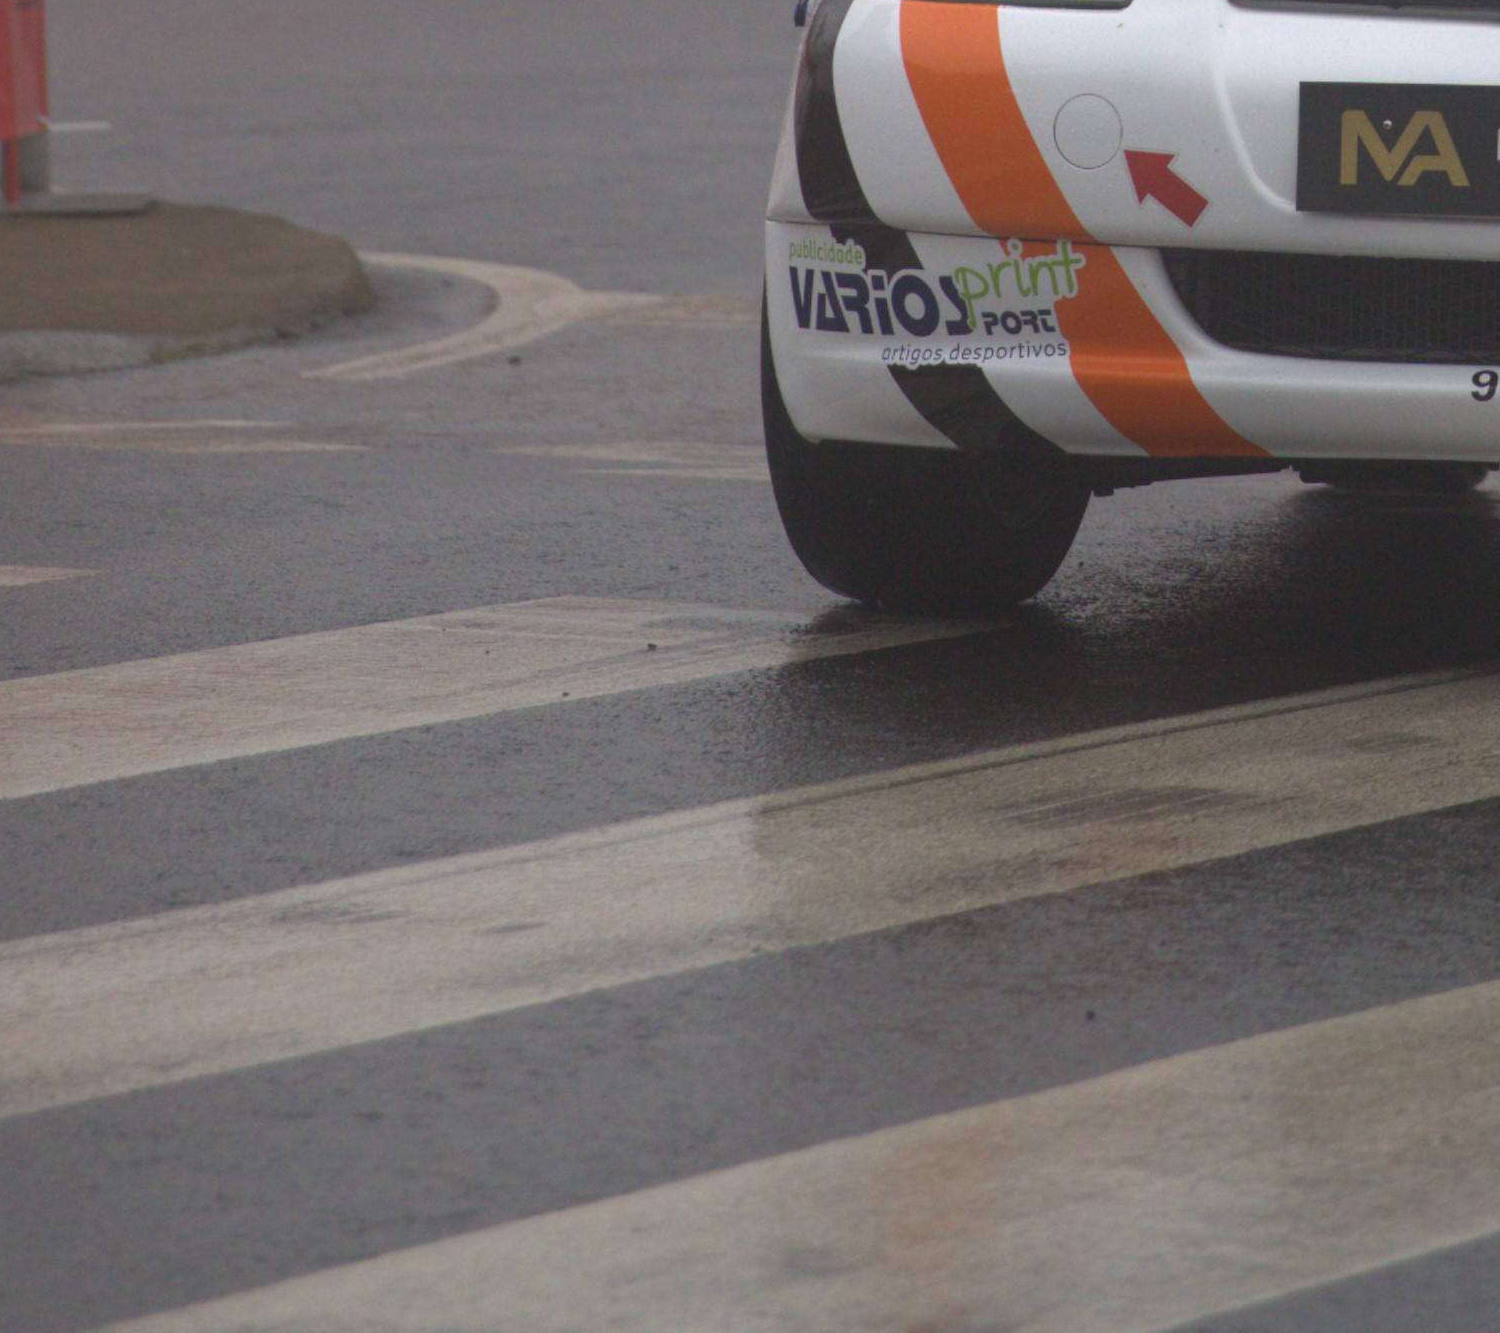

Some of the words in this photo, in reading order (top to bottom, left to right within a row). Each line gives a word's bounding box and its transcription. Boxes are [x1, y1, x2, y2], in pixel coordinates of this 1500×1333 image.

[788, 238, 864, 267] publicidade
[954, 239, 1083, 331] print
[880, 343, 944, 364] artigos
[948, 338, 1068, 366] desportivos
